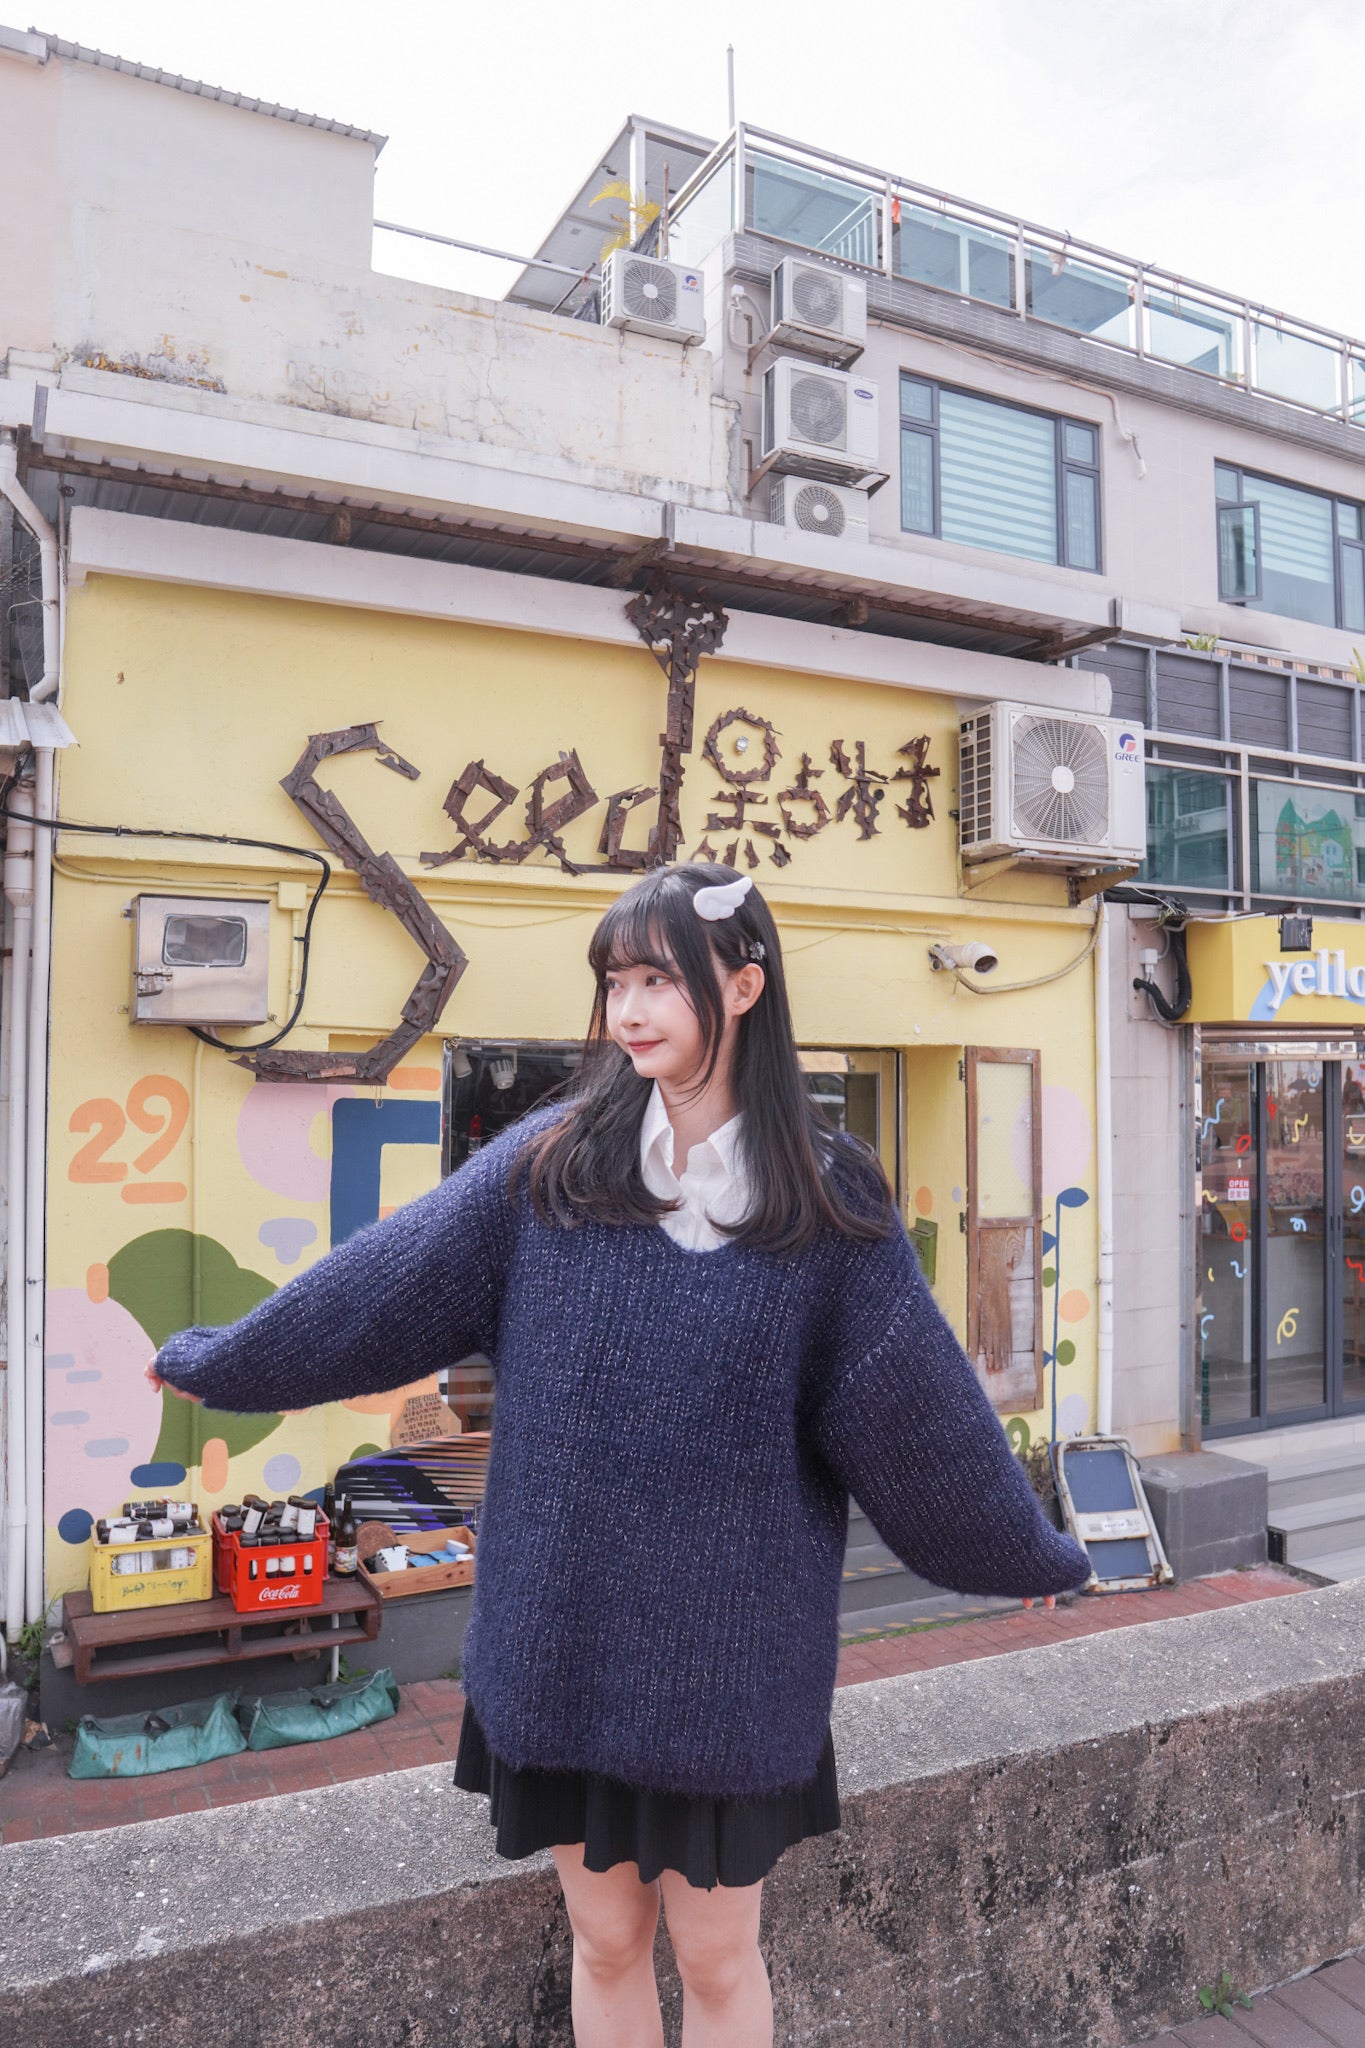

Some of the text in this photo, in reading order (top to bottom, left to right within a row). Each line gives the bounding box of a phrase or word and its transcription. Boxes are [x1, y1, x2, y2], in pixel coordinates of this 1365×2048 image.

[1115, 752, 1141, 763] GREE
[230, 578, 728, 1086] Seed
[1263, 948, 1365, 1010] yello
[68, 1074, 190, 1184] 29
[1229, 1179, 1249, 1188] OPEN
